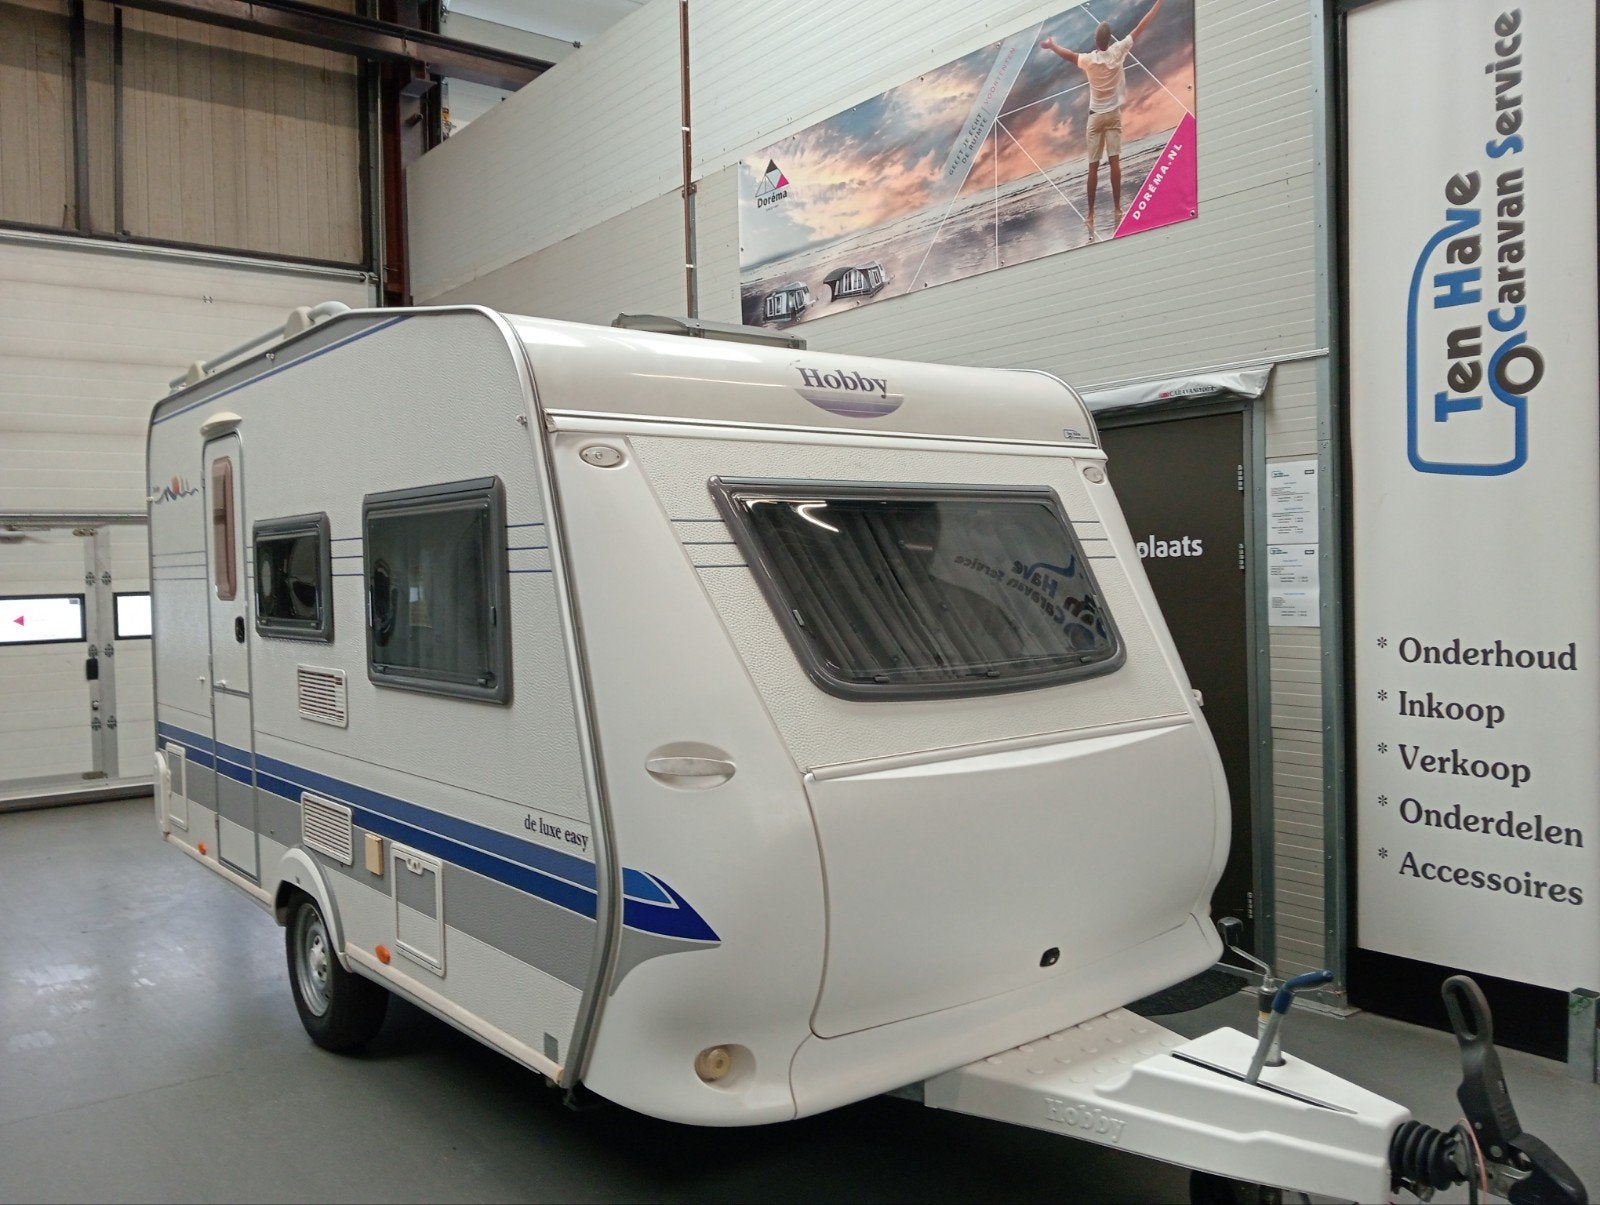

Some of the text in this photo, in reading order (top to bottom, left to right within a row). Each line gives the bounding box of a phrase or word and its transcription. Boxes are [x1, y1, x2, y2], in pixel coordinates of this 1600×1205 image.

[968, 114, 982, 136] ECHT
[968, 119, 987, 150] RUIMTE
[1132, 144, 1182, 220] DORÉMA.NL
[1485, 7, 1527, 332] Caravan Service
[757, 190, 788, 208] Doréma
[1434, 170, 1483, 422] Ten Have
[795, 366, 887, 399] Hobby
[1399, 636, 1578, 671] Onderhoud
[1398, 690, 1505, 729] Inkoop
[1398, 743, 1531, 789] Verkoop
[524, 814, 588, 853] de luxe easy
[1399, 797, 1584, 848] Onderdelen
[1398, 851, 1583, 906] Accessoires
[1044, 1097, 1126, 1144] Hobby
